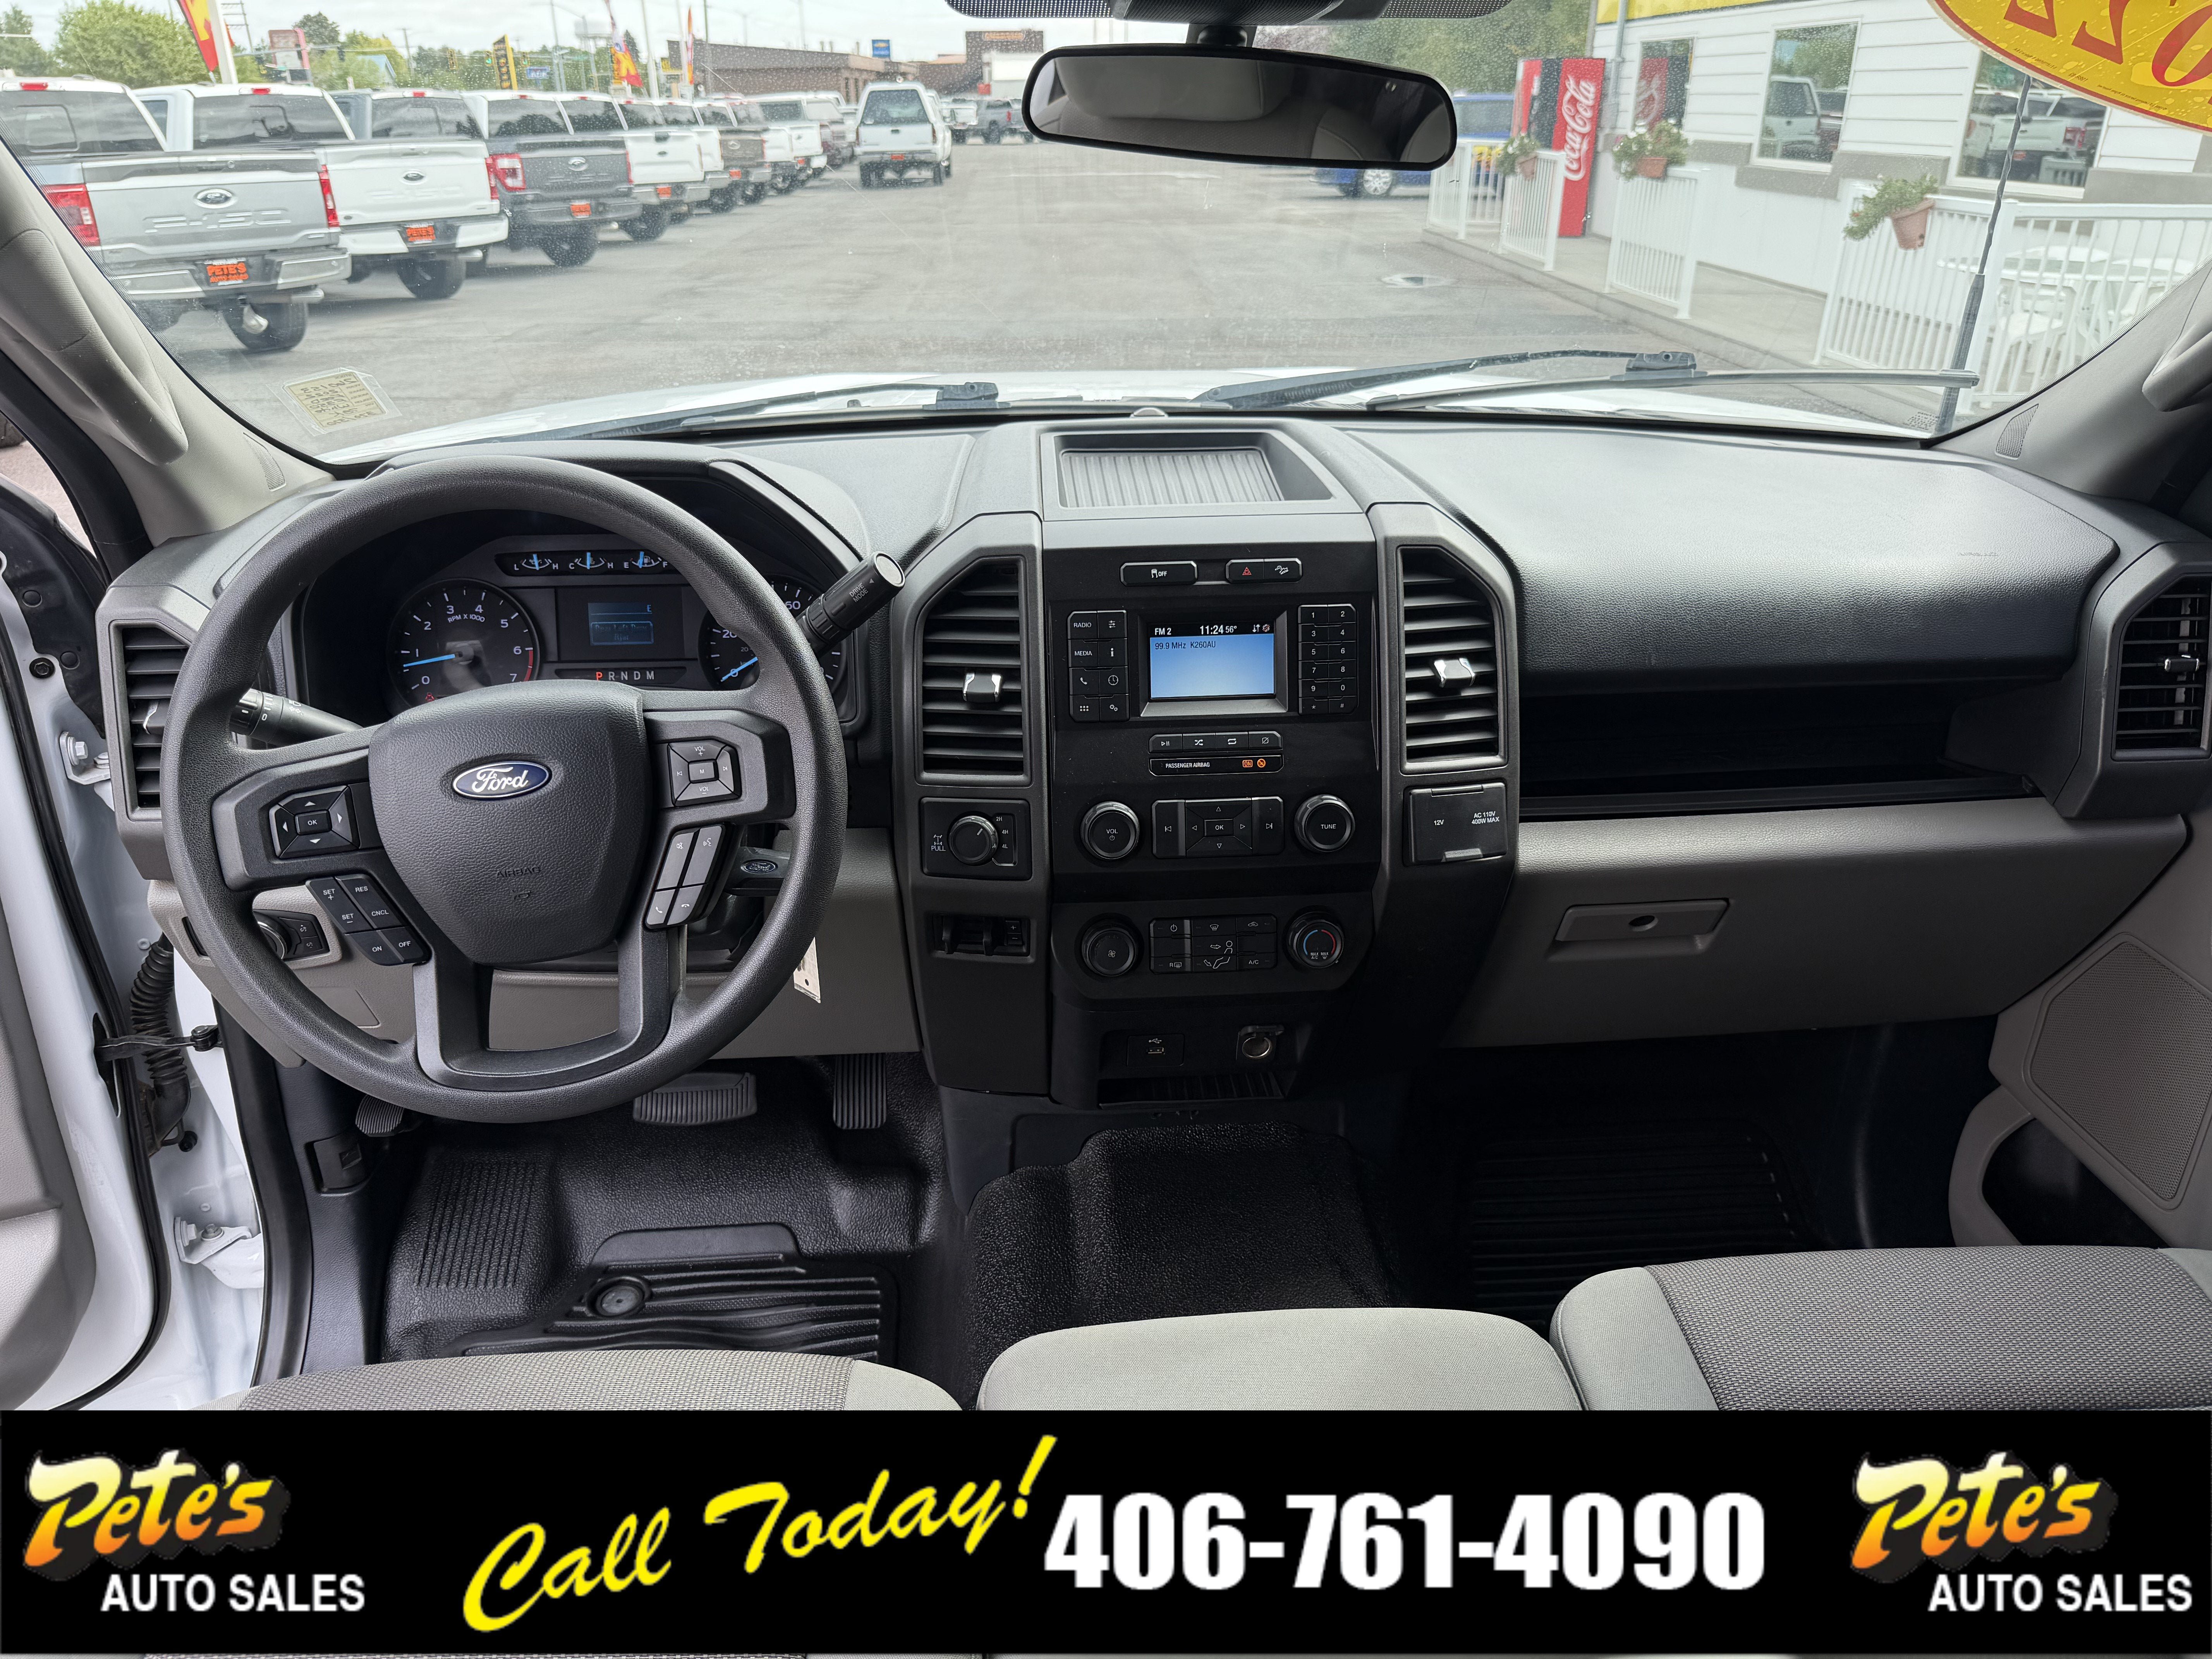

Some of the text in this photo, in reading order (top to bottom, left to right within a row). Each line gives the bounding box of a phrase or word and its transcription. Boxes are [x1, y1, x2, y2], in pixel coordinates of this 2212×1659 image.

[849, 583, 864, 597] DRIVE
[853, 588, 868, 602] MODE
[447, 605, 454, 614] 3
[475, 605, 483, 613] 4
[470, 614, 485, 622] 1000
[424, 622, 431, 630] 2
[501, 620, 508, 628] 5
[1200, 625, 1224, 635] 11:24
[416, 649, 419, 657] 1
[514, 646, 522, 654] 6
[422, 676, 430, 684] 0
[596, 672, 603, 680] P
[621, 672, 628, 680] N
[634, 672, 641, 680] D
[647, 671, 654, 680] M
[472, 767, 529, 793] Ford
[749, 862, 771, 871] Ford
[496, 866, 542, 878] AIRBAG
